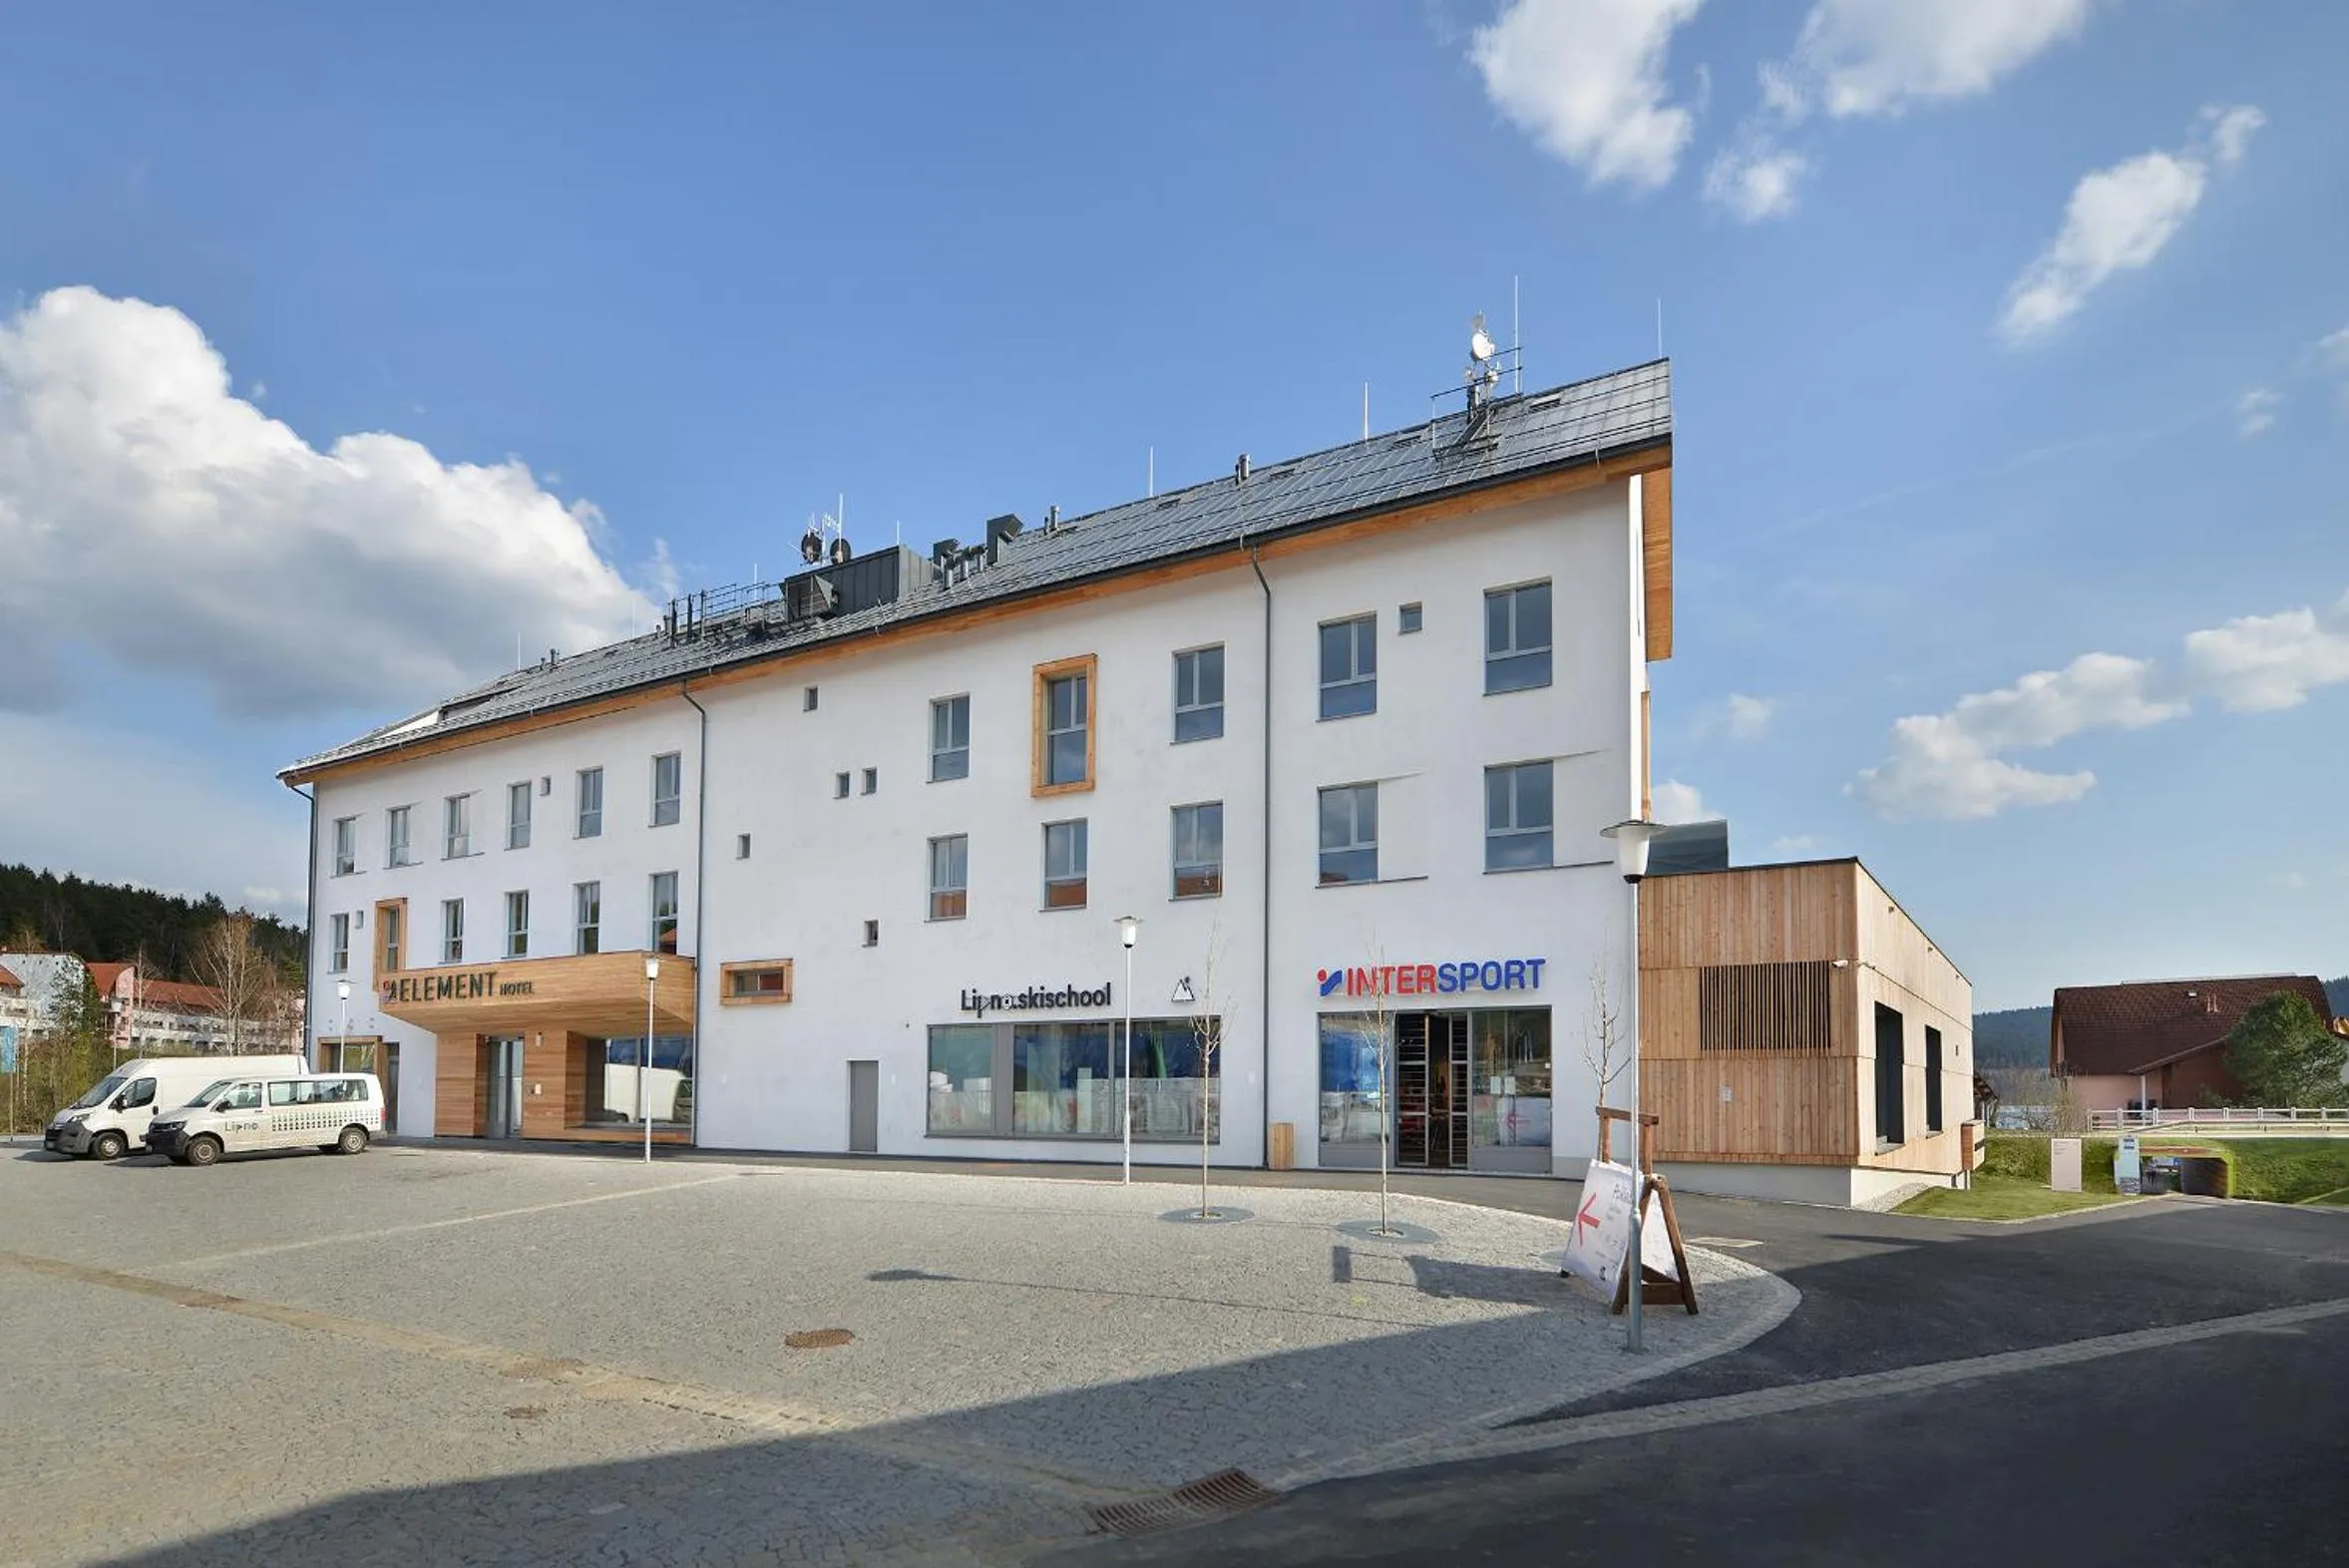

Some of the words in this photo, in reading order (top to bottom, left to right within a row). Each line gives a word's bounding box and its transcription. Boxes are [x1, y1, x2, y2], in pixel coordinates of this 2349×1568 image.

[400, 972, 497, 1001] ELEMENT
[500, 980, 535, 995] HOTEL
[1348, 959, 1545, 995] INTERSPORT
